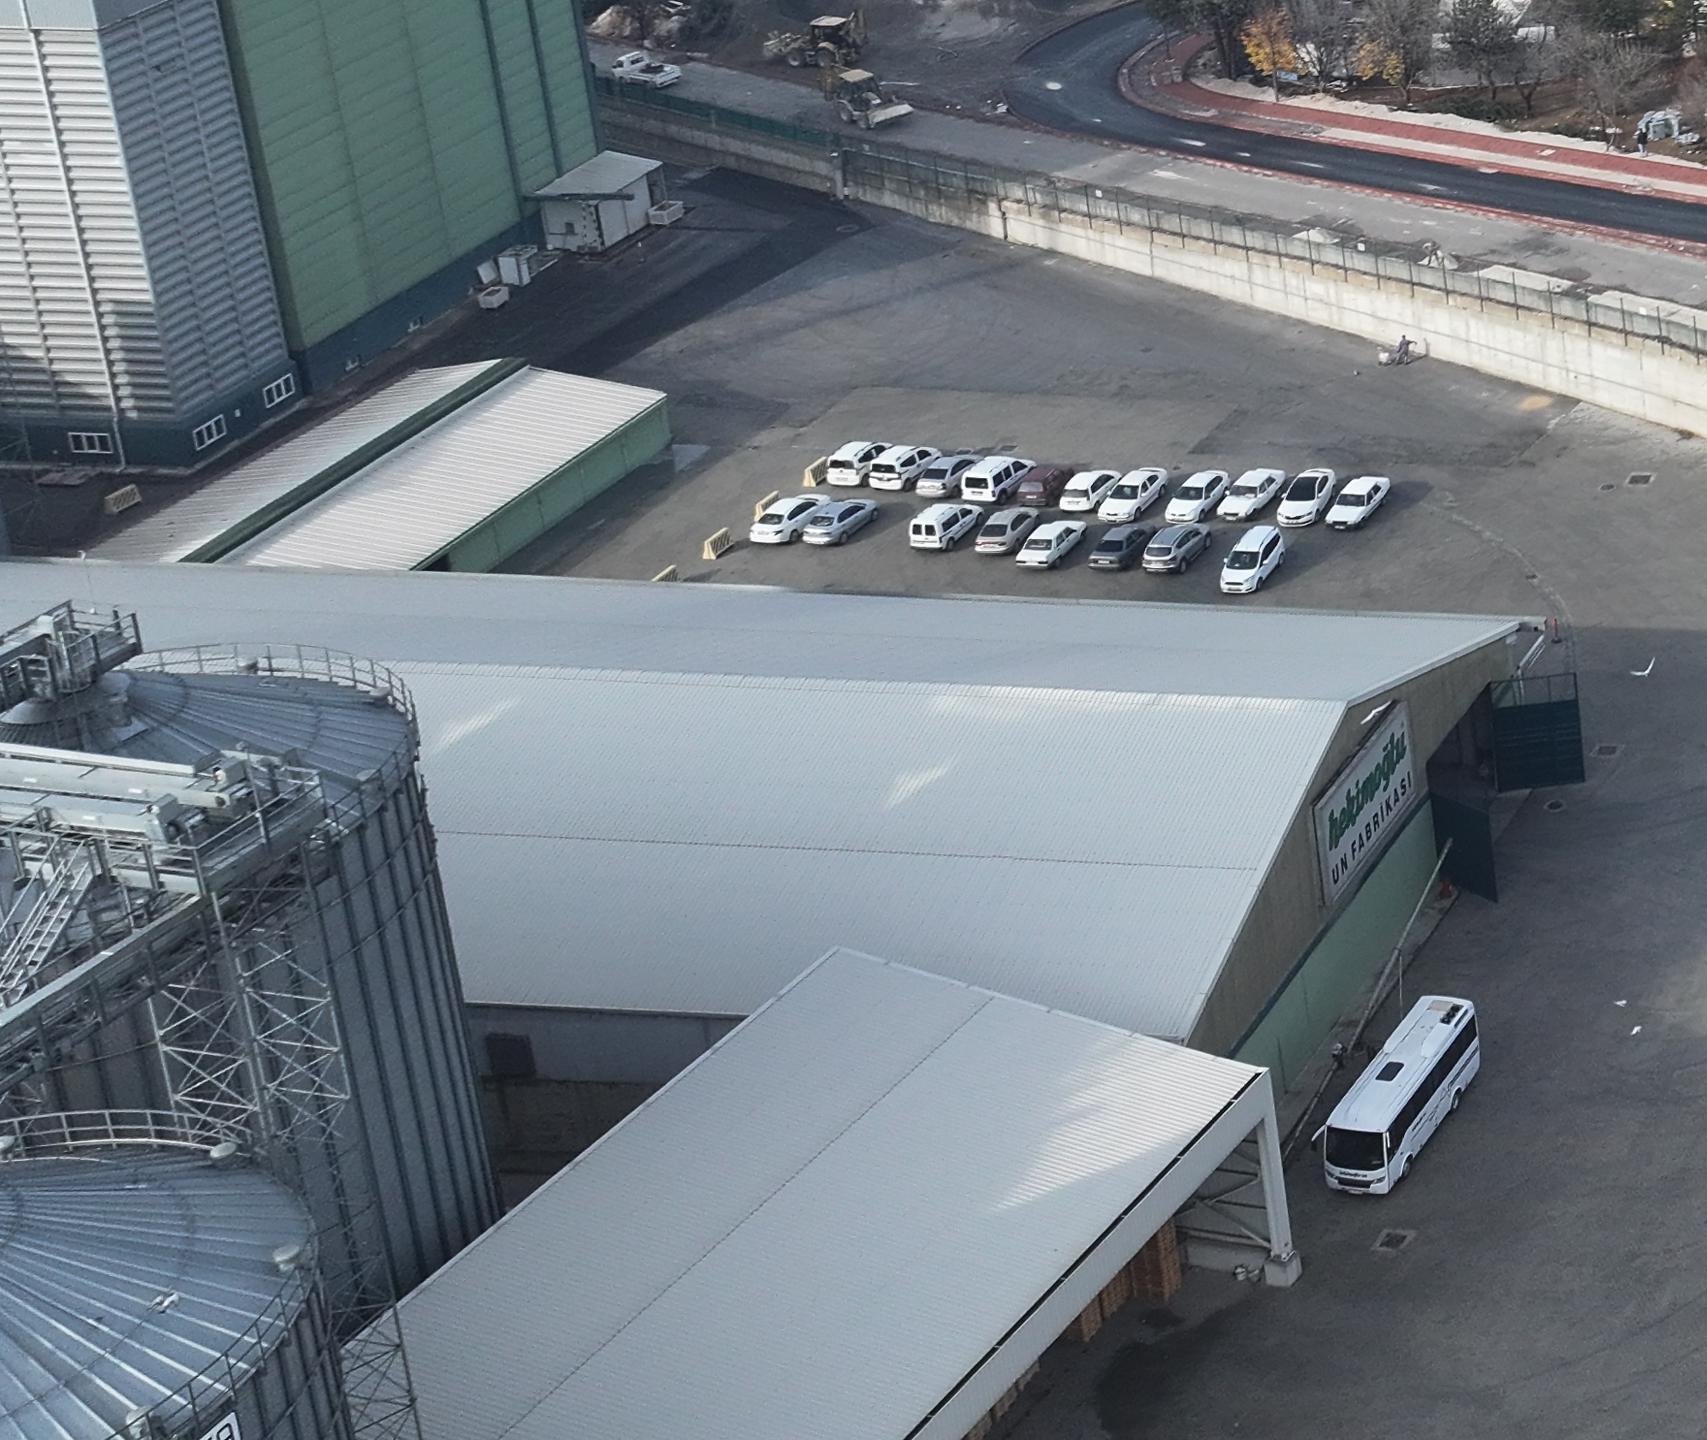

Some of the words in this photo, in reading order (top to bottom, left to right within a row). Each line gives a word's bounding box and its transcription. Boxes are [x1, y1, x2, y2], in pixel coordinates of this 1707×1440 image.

[1328, 730, 1408, 852] hekimoğlu
[1332, 854, 1349, 885] UN
[1350, 770, 1412, 861] FABRİKASI
